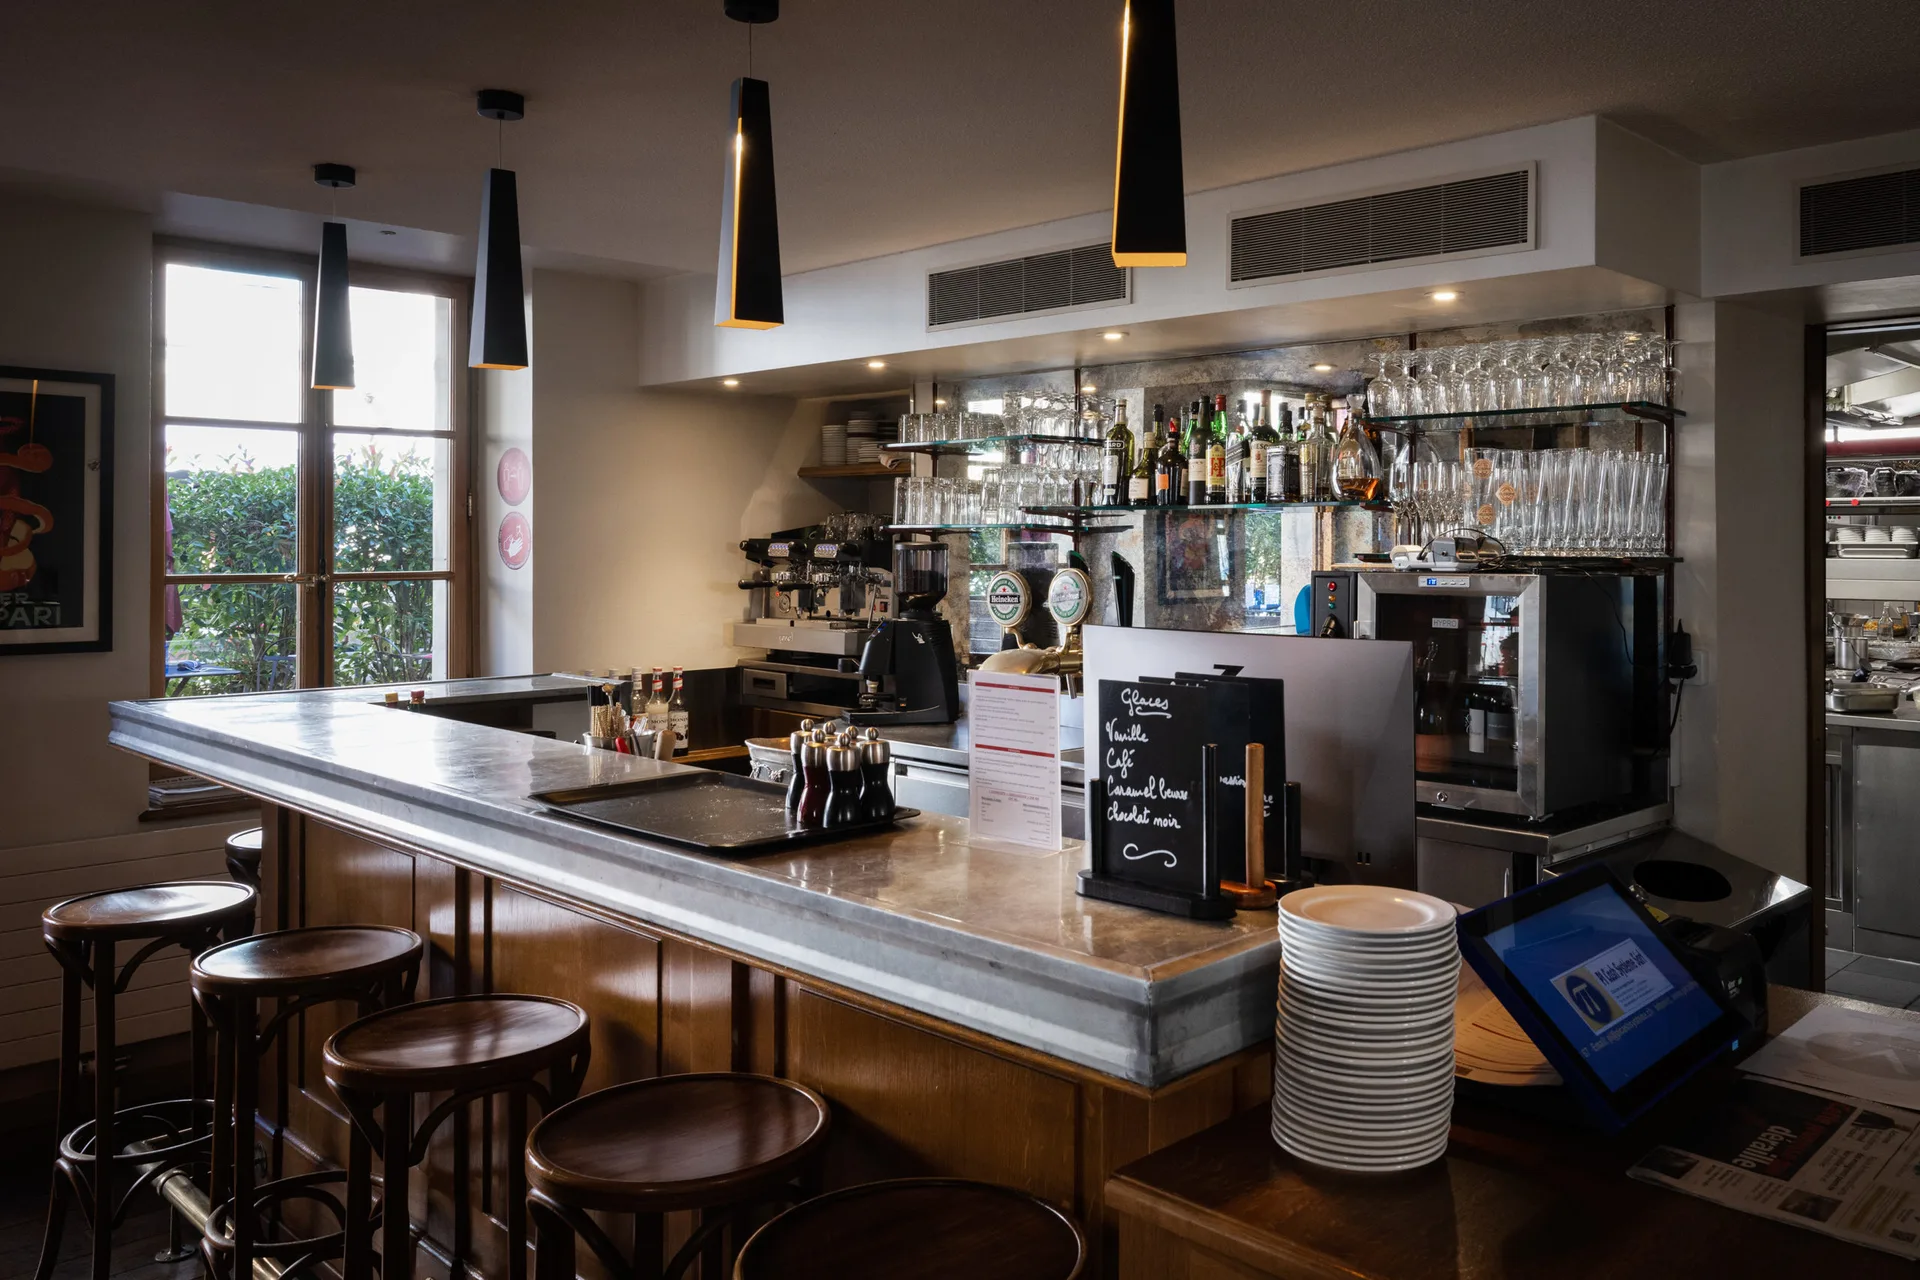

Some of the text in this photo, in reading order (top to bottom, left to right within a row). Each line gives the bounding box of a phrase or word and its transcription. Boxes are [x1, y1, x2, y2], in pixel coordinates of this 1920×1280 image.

[991, 595, 1019, 603] Heineken
[1433, 619, 1458, 628] HYPRO
[1121, 688, 1170, 716] Glaces
[1105, 718, 1149, 743] Vanille
[1106, 747, 1135, 779] Café
[1107, 775, 1157, 800] Caramel
[1153, 813, 1182, 829] noir
[1731, 1123, 1797, 1170] déraille
